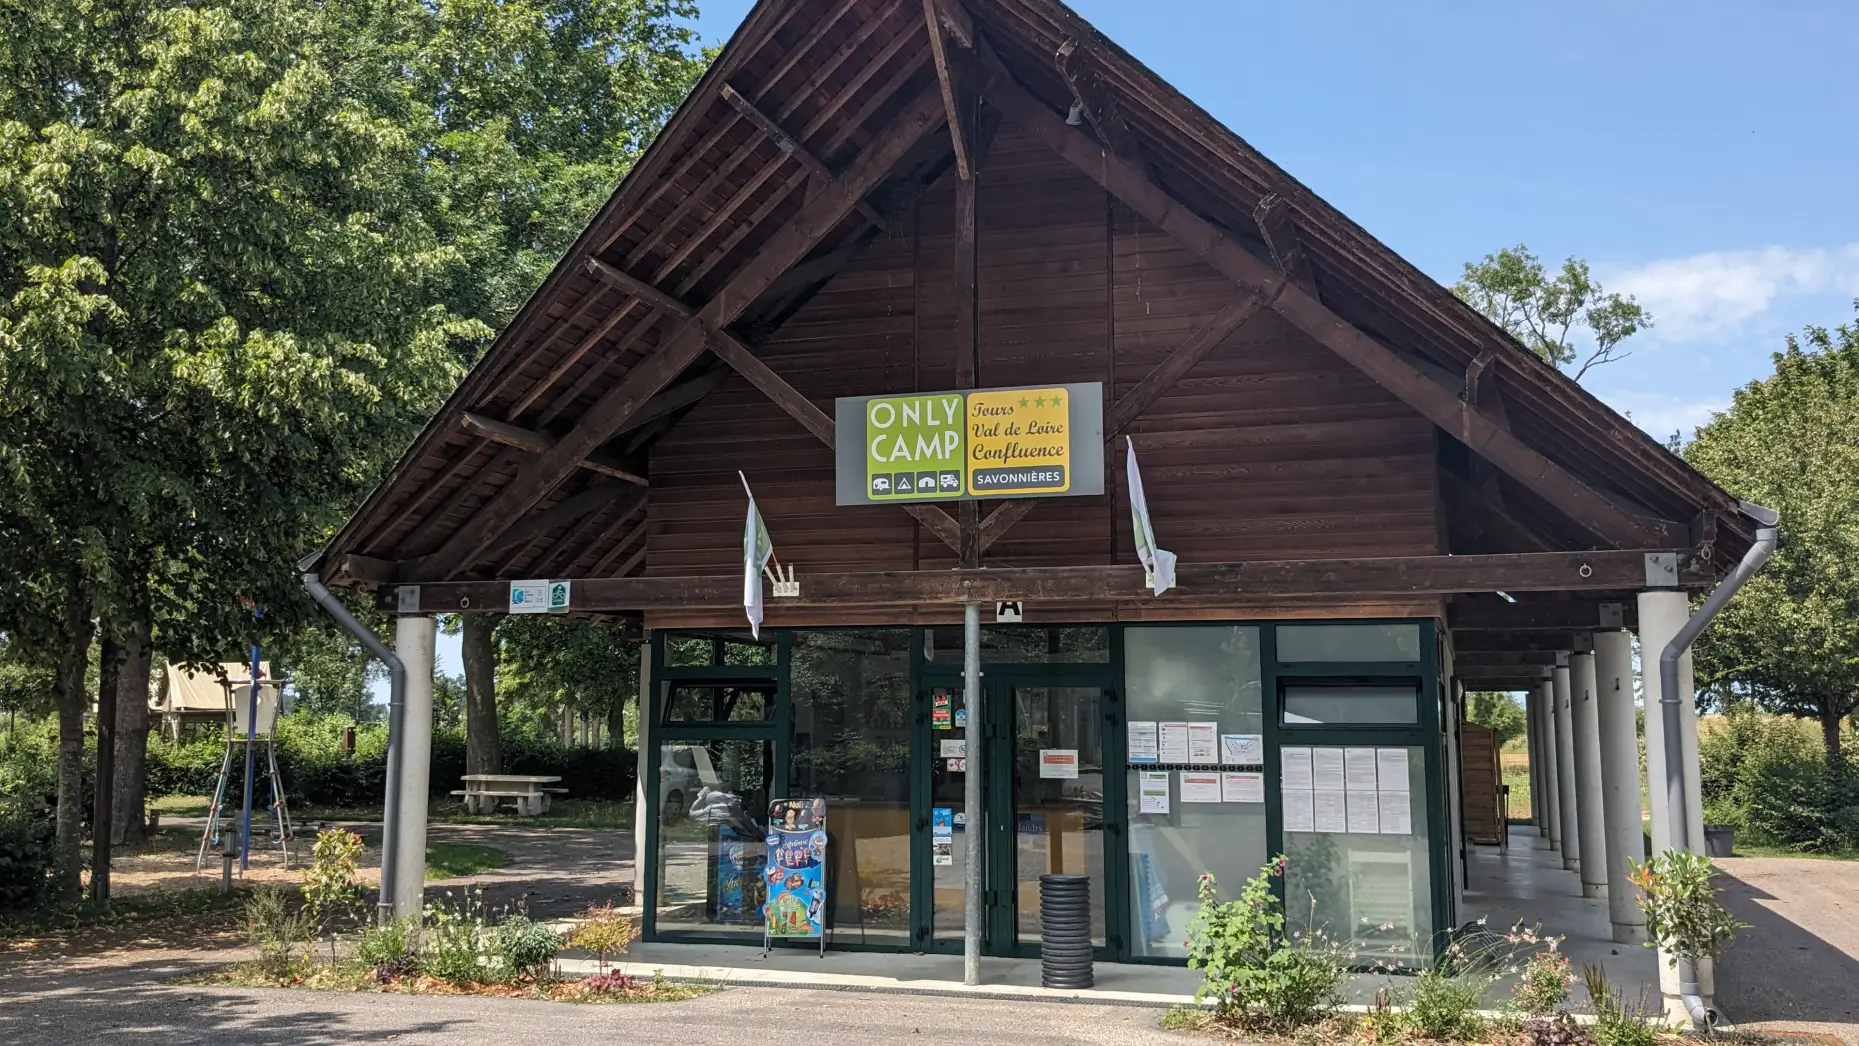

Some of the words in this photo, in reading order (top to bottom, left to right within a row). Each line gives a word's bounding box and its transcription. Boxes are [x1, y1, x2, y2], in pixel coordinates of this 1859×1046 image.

[871, 398, 959, 429] ONLY
[972, 402, 1014, 417] Tours
[972, 422, 1000, 438] Val
[1004, 421, 1022, 436] de
[1026, 420, 1064, 435] Loire
[871, 430, 959, 462] CAMP
[972, 442, 1065, 464] Confluence
[977, 471, 1060, 484] SAVONNIÈRES
